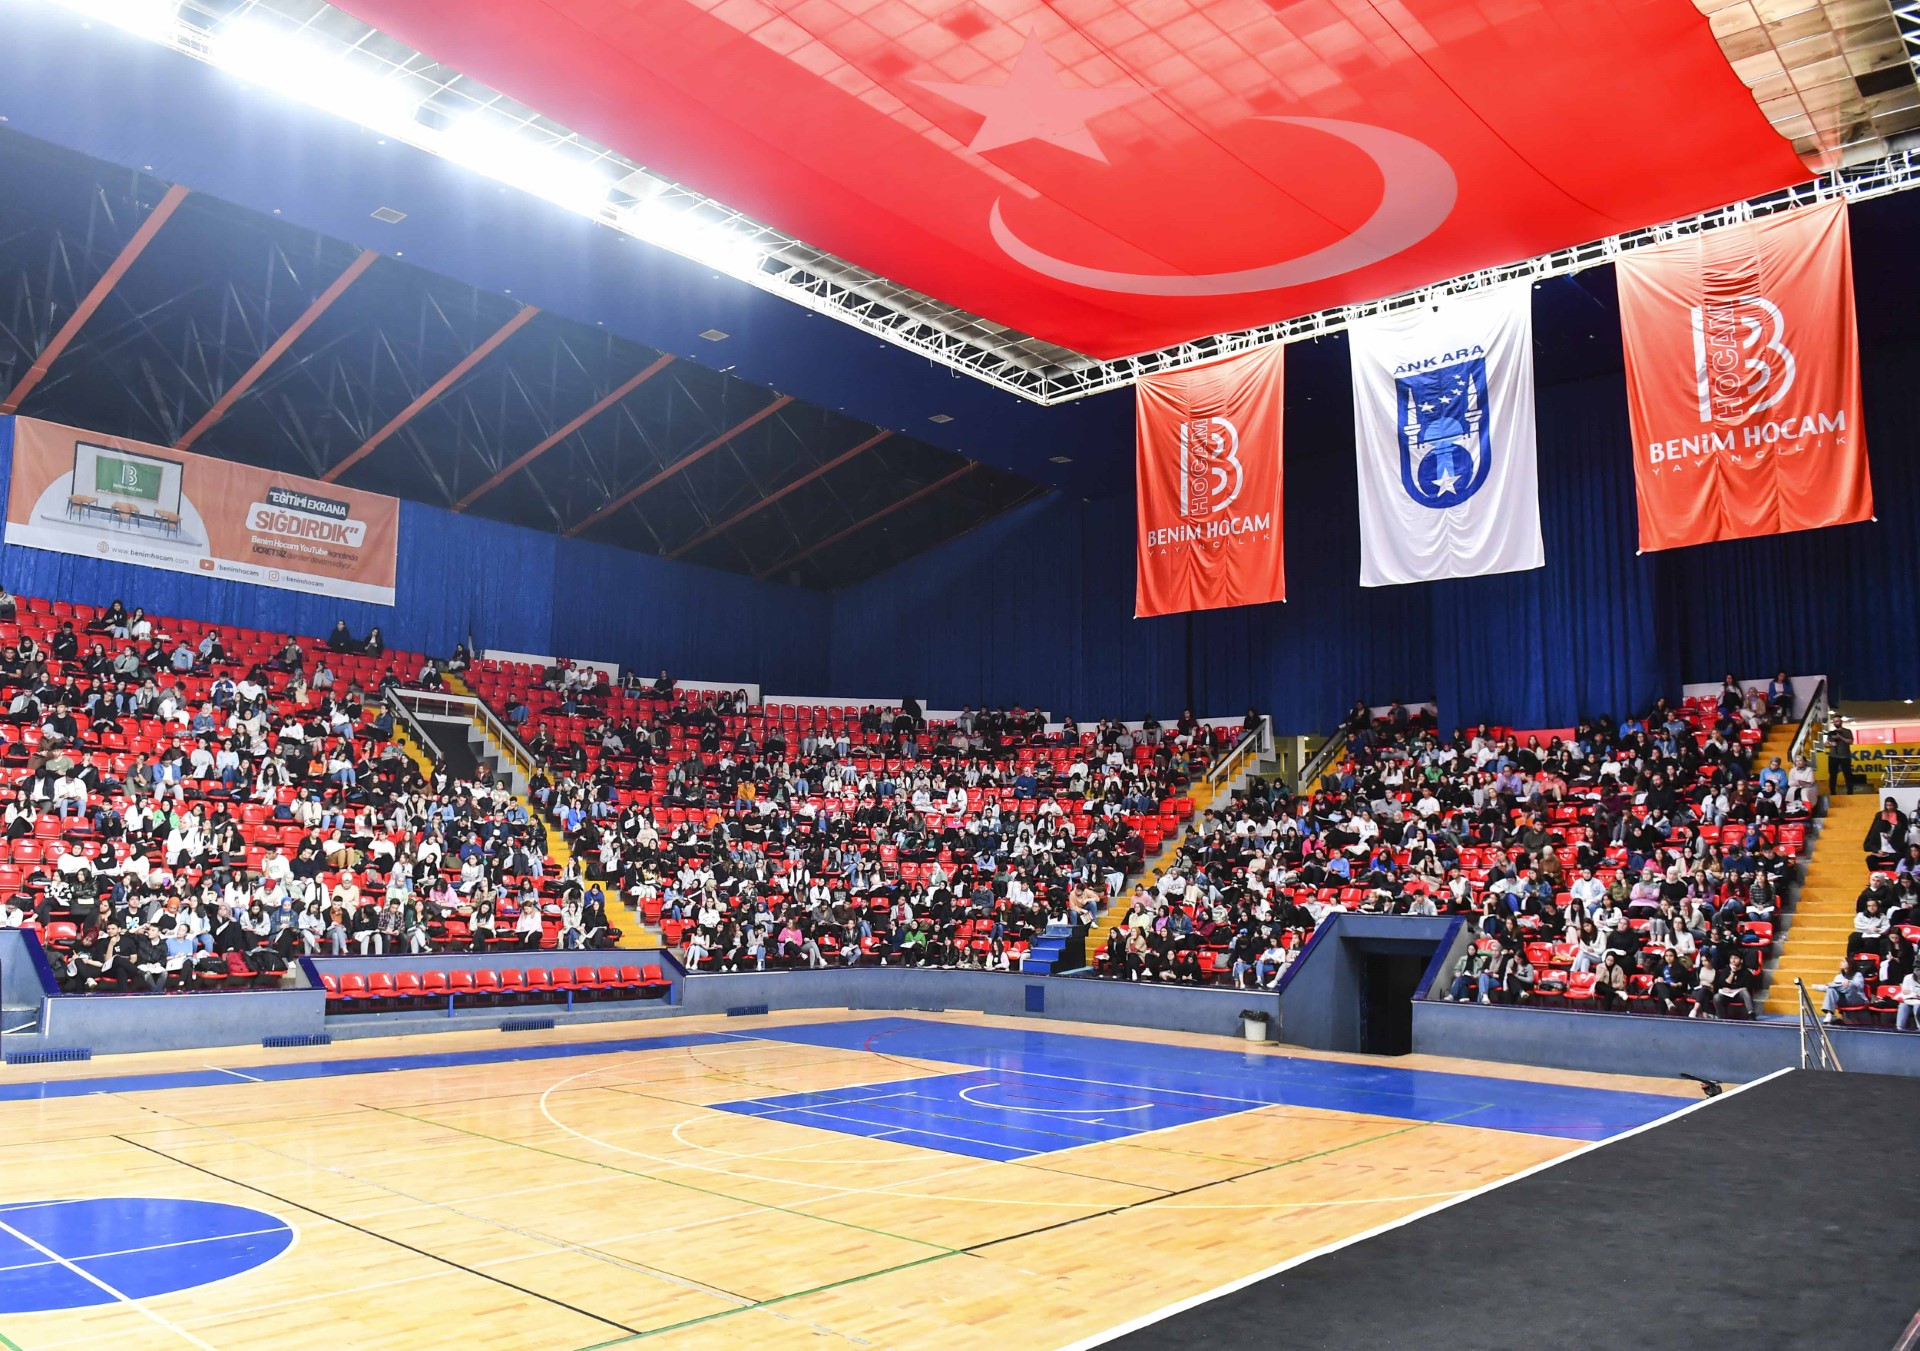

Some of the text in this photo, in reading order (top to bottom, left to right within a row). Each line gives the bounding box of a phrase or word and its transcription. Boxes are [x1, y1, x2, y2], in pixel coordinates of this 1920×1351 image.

[1393, 345, 1485, 375] ANKARA
[1708, 302, 1744, 420] HOCAM
[1743, 410, 1846, 448] HOCAM
[1190, 418, 1209, 515] HOCAM
[1652, 436, 1847, 476] YAYINCILIK
[306, 500, 346, 516] EKRANA
[255, 509, 359, 544] SIĞDIRDIK"
[1206, 512, 1270, 539] HOCAM
[251, 535, 274, 547] Benim
[273, 539, 299, 551] Hocam
[299, 544, 328, 556] YouTube
[252, 544, 287, 559] ÜCRETSİZ
[1148, 533, 1270, 557] YAYINCILIK
